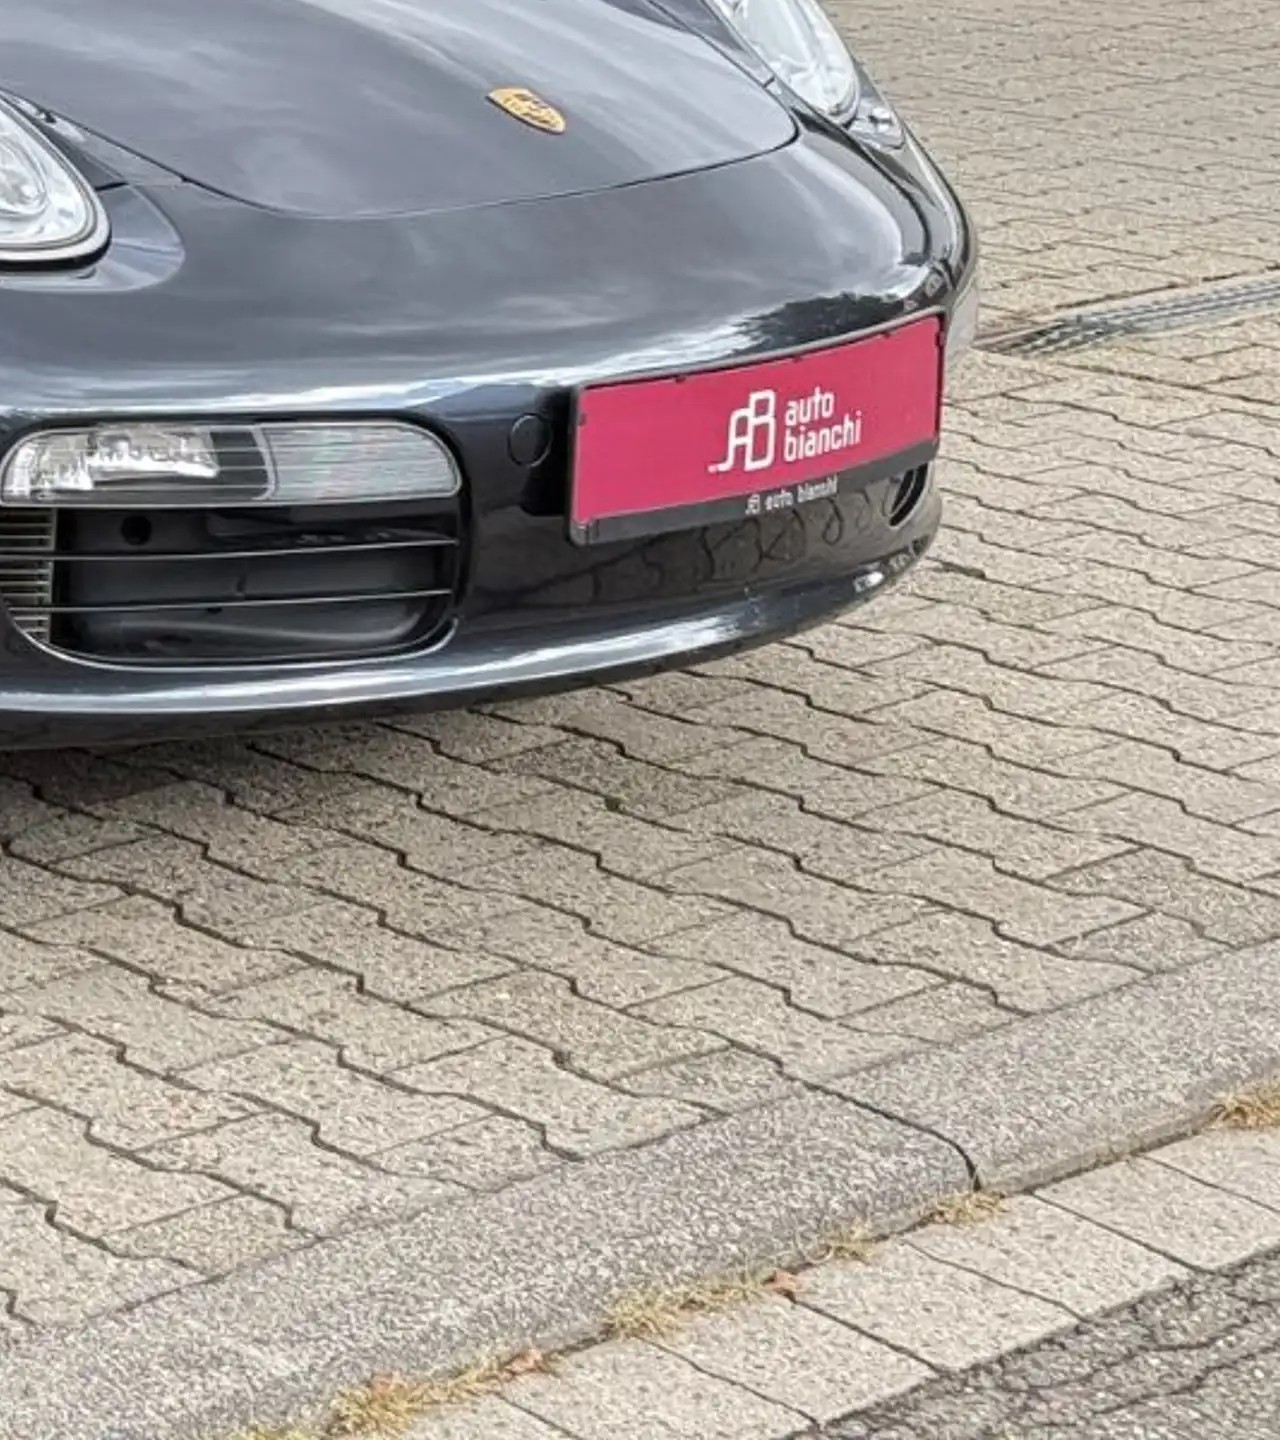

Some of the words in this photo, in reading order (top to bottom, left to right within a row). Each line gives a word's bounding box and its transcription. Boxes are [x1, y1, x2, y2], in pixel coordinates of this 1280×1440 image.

[785, 386, 835, 426] auto
[784, 410, 862, 462] bianchi
[764, 488, 794, 511] auto
